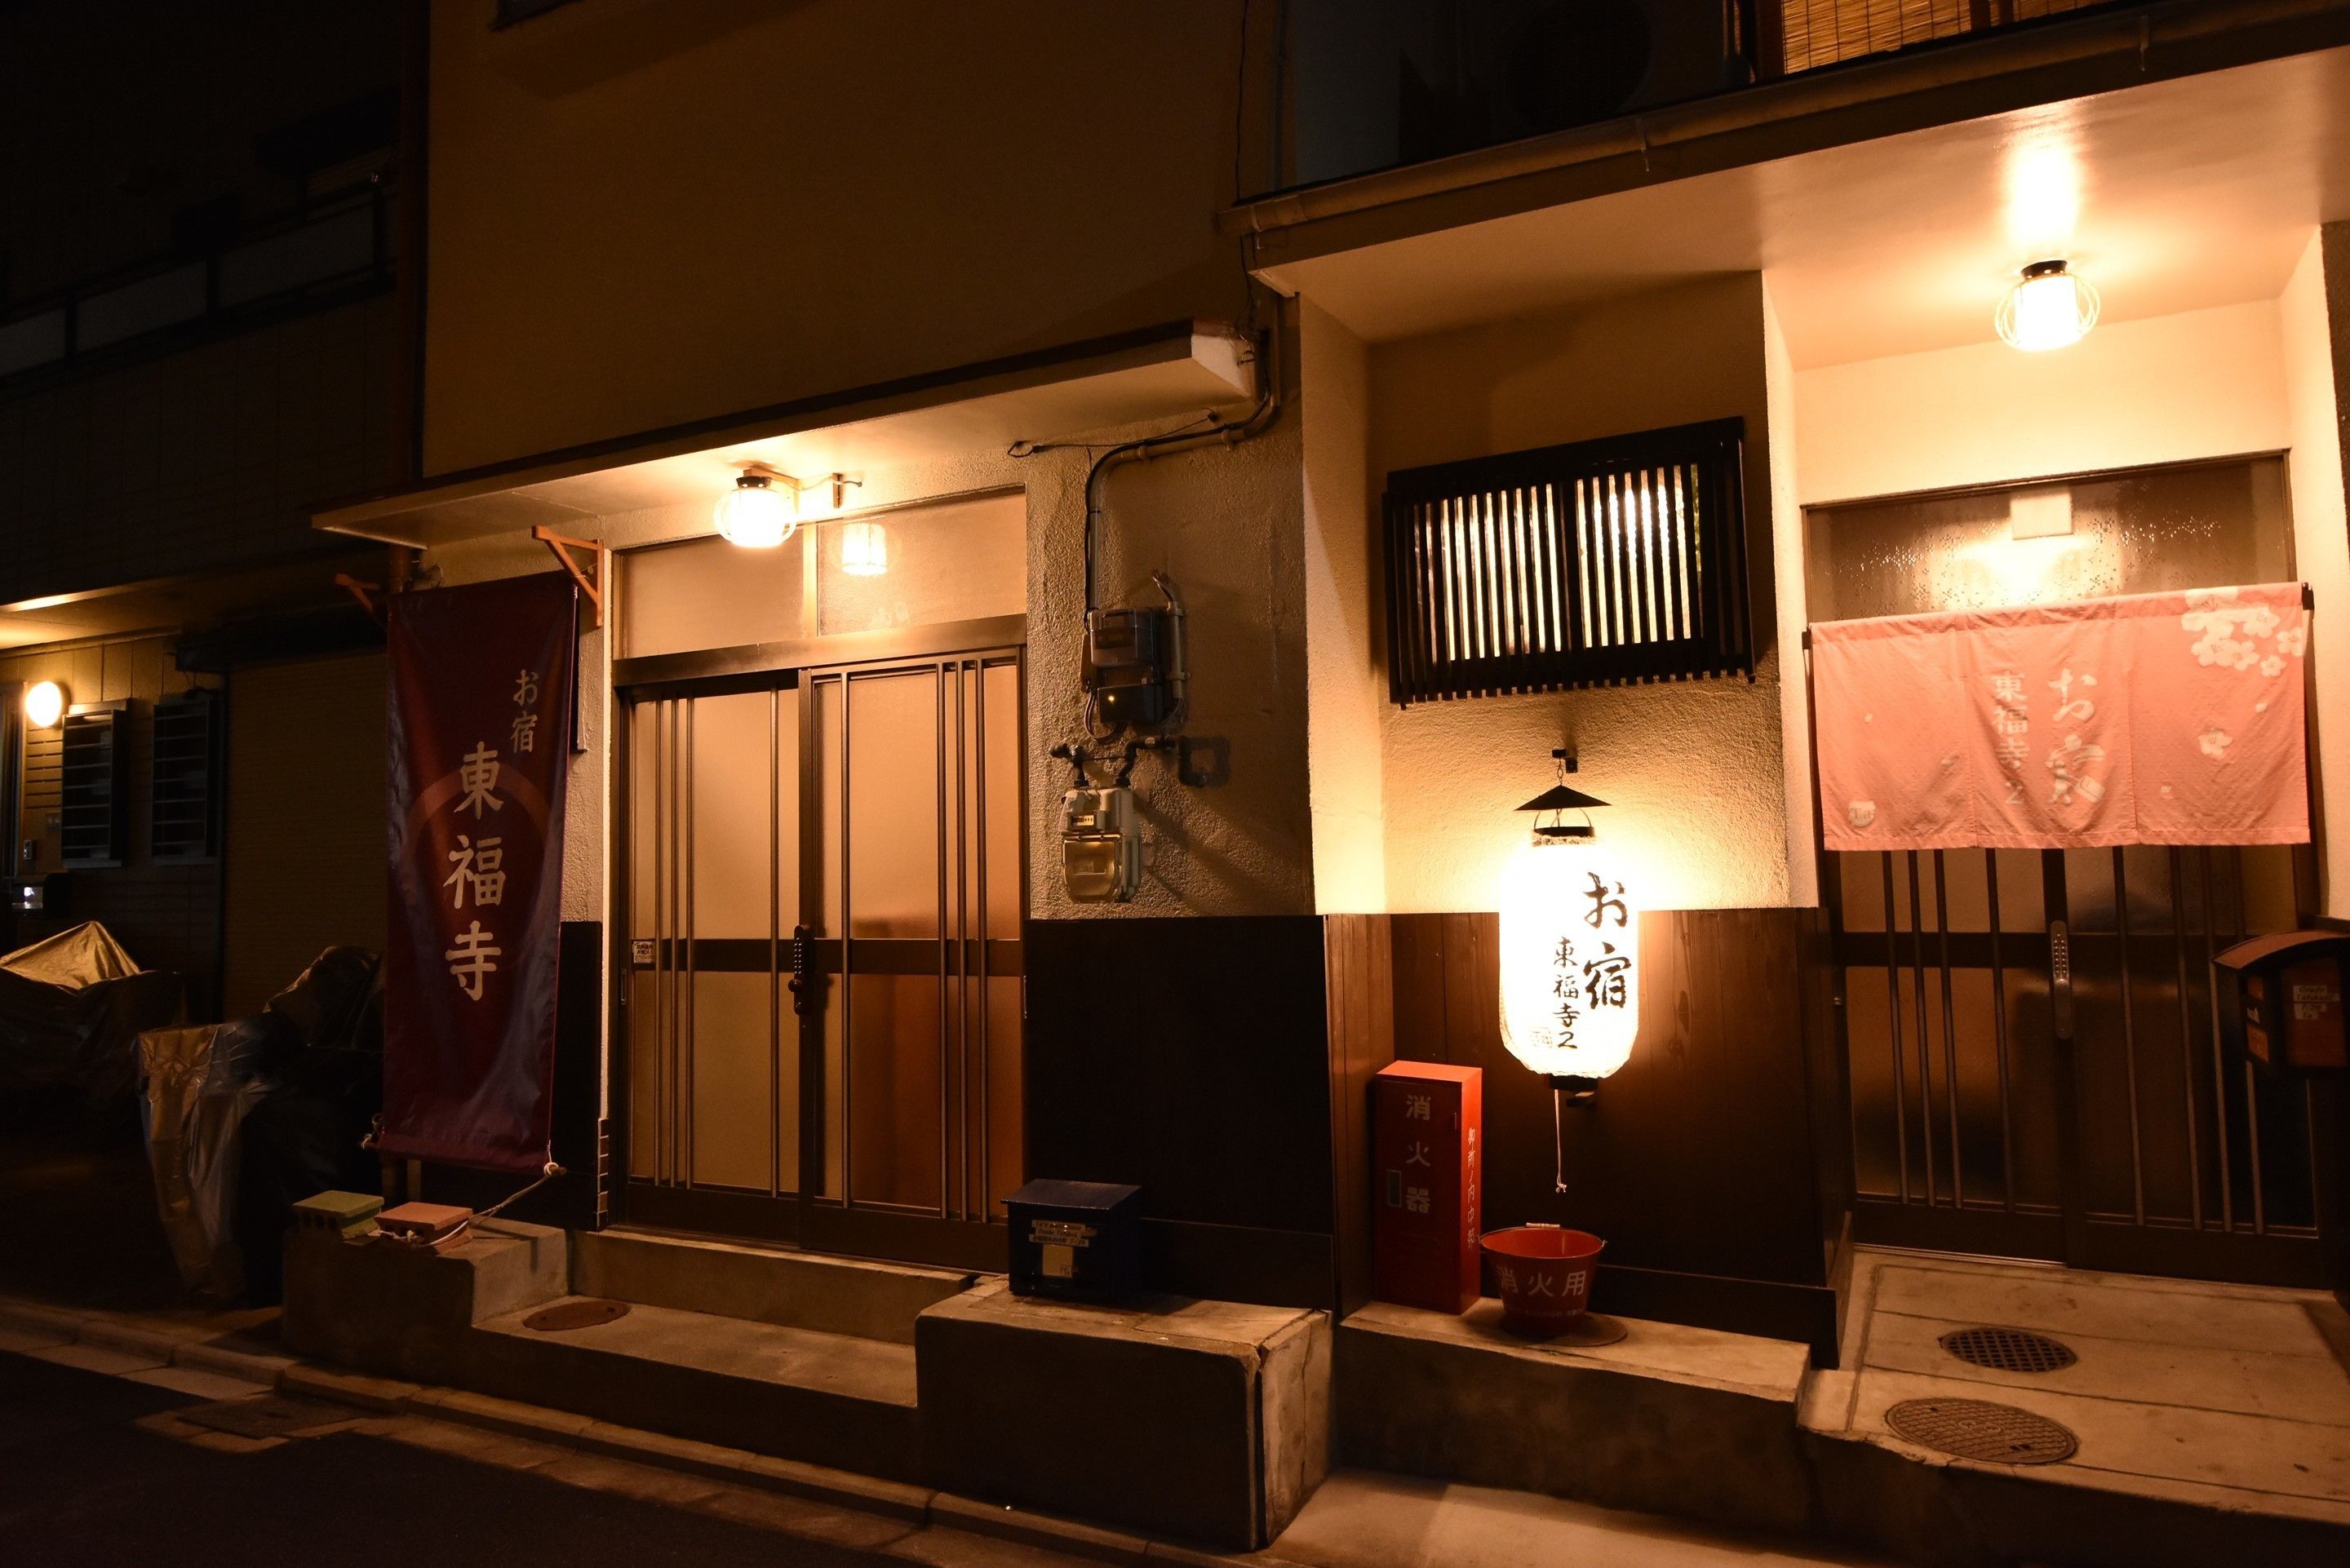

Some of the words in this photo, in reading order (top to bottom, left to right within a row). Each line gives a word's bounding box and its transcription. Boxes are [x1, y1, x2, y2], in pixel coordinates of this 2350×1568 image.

[512, 668, 539, 755] お宿
[442, 741, 507, 1001] 東福寺
[1553, 936, 1581, 1049] 東福寺2
[1582, 871, 1632, 1009] お宿
[1406, 1093, 1432, 1214] 消火器
[1496, 1265, 1587, 1297] 消火用
